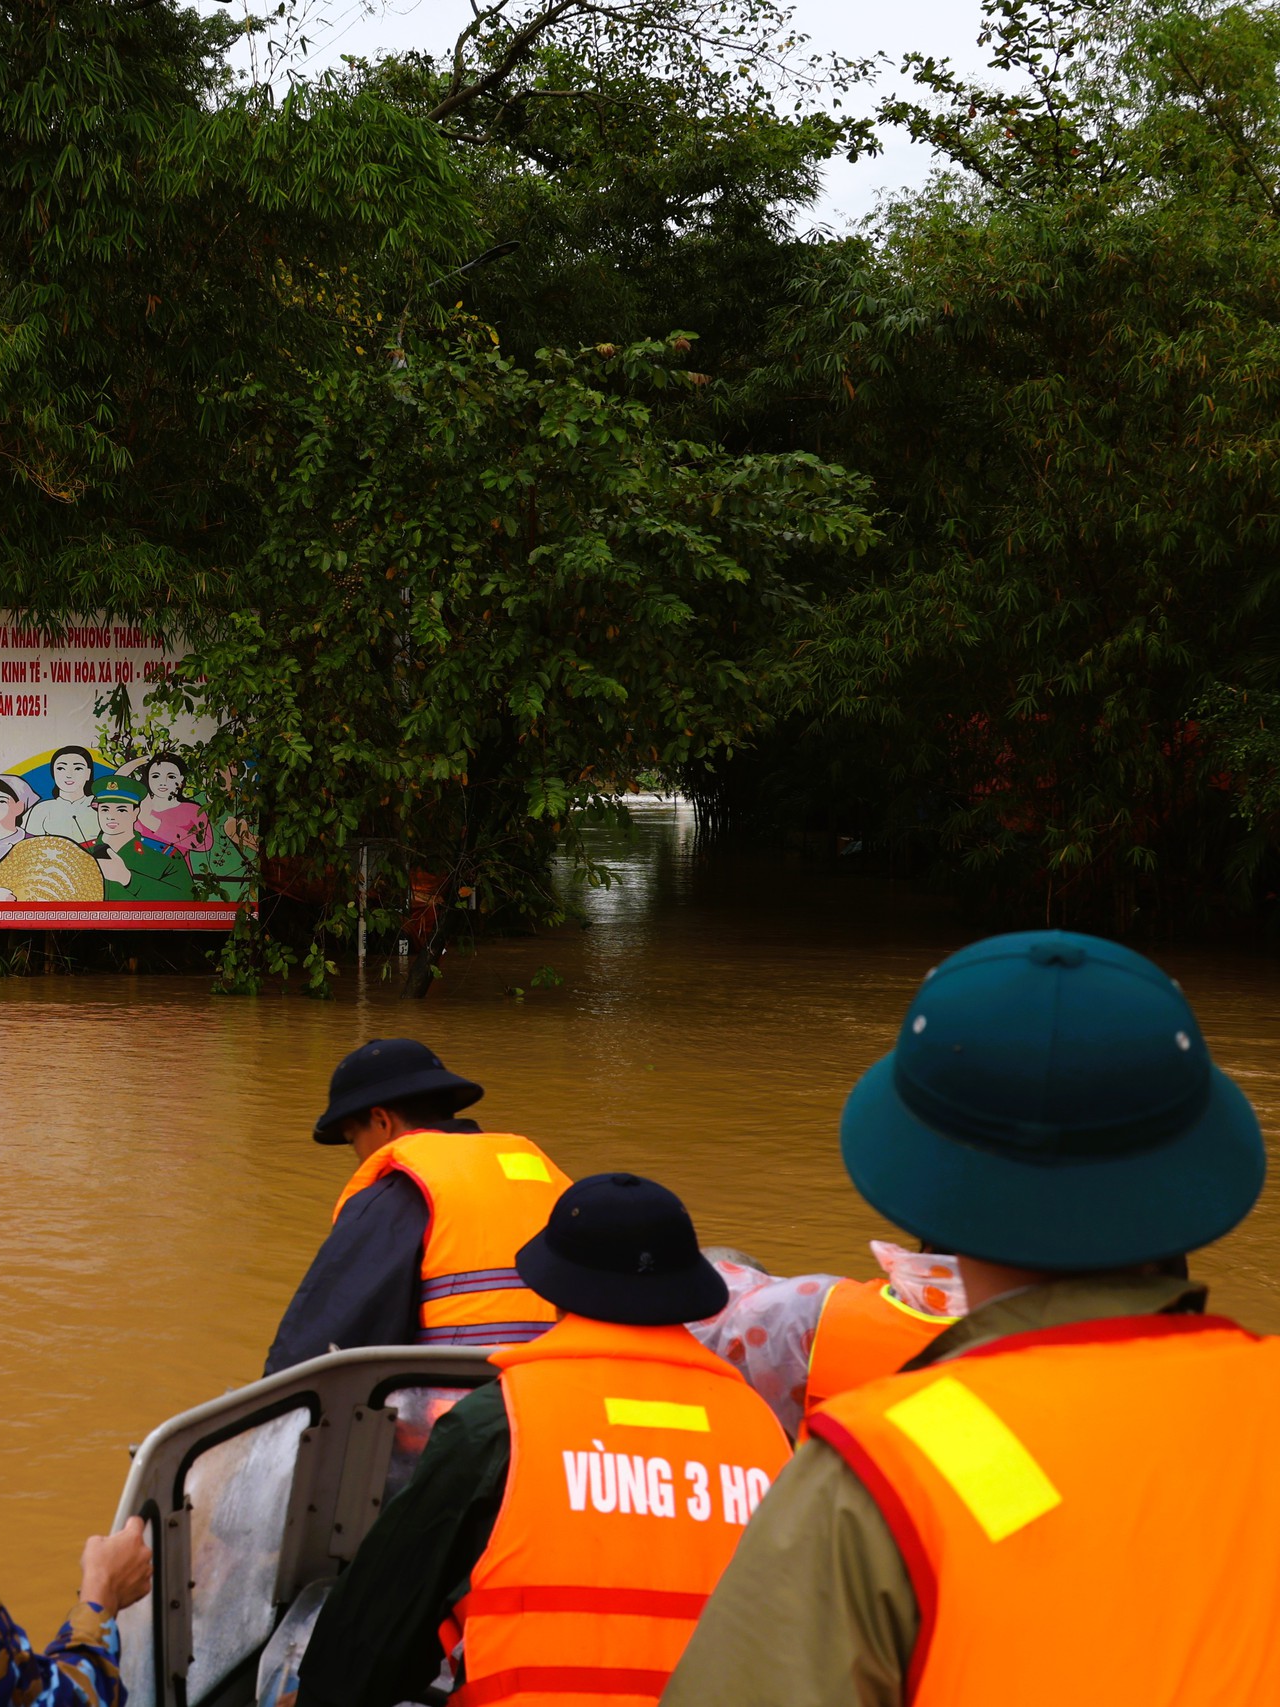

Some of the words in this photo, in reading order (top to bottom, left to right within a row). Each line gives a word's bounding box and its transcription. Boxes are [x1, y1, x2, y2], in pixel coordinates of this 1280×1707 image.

[44, 624, 65, 648] DN
[2, 661, 26, 683] KINH
[30, 655, 41, 683] TẾ
[50, 658, 71, 683] VĂN
[74, 657, 96, 683] HÓA
[16, 695, 41, 717] 2025
[561, 1438, 676, 1519] VÙNG
[684, 1460, 711, 1522] 3
